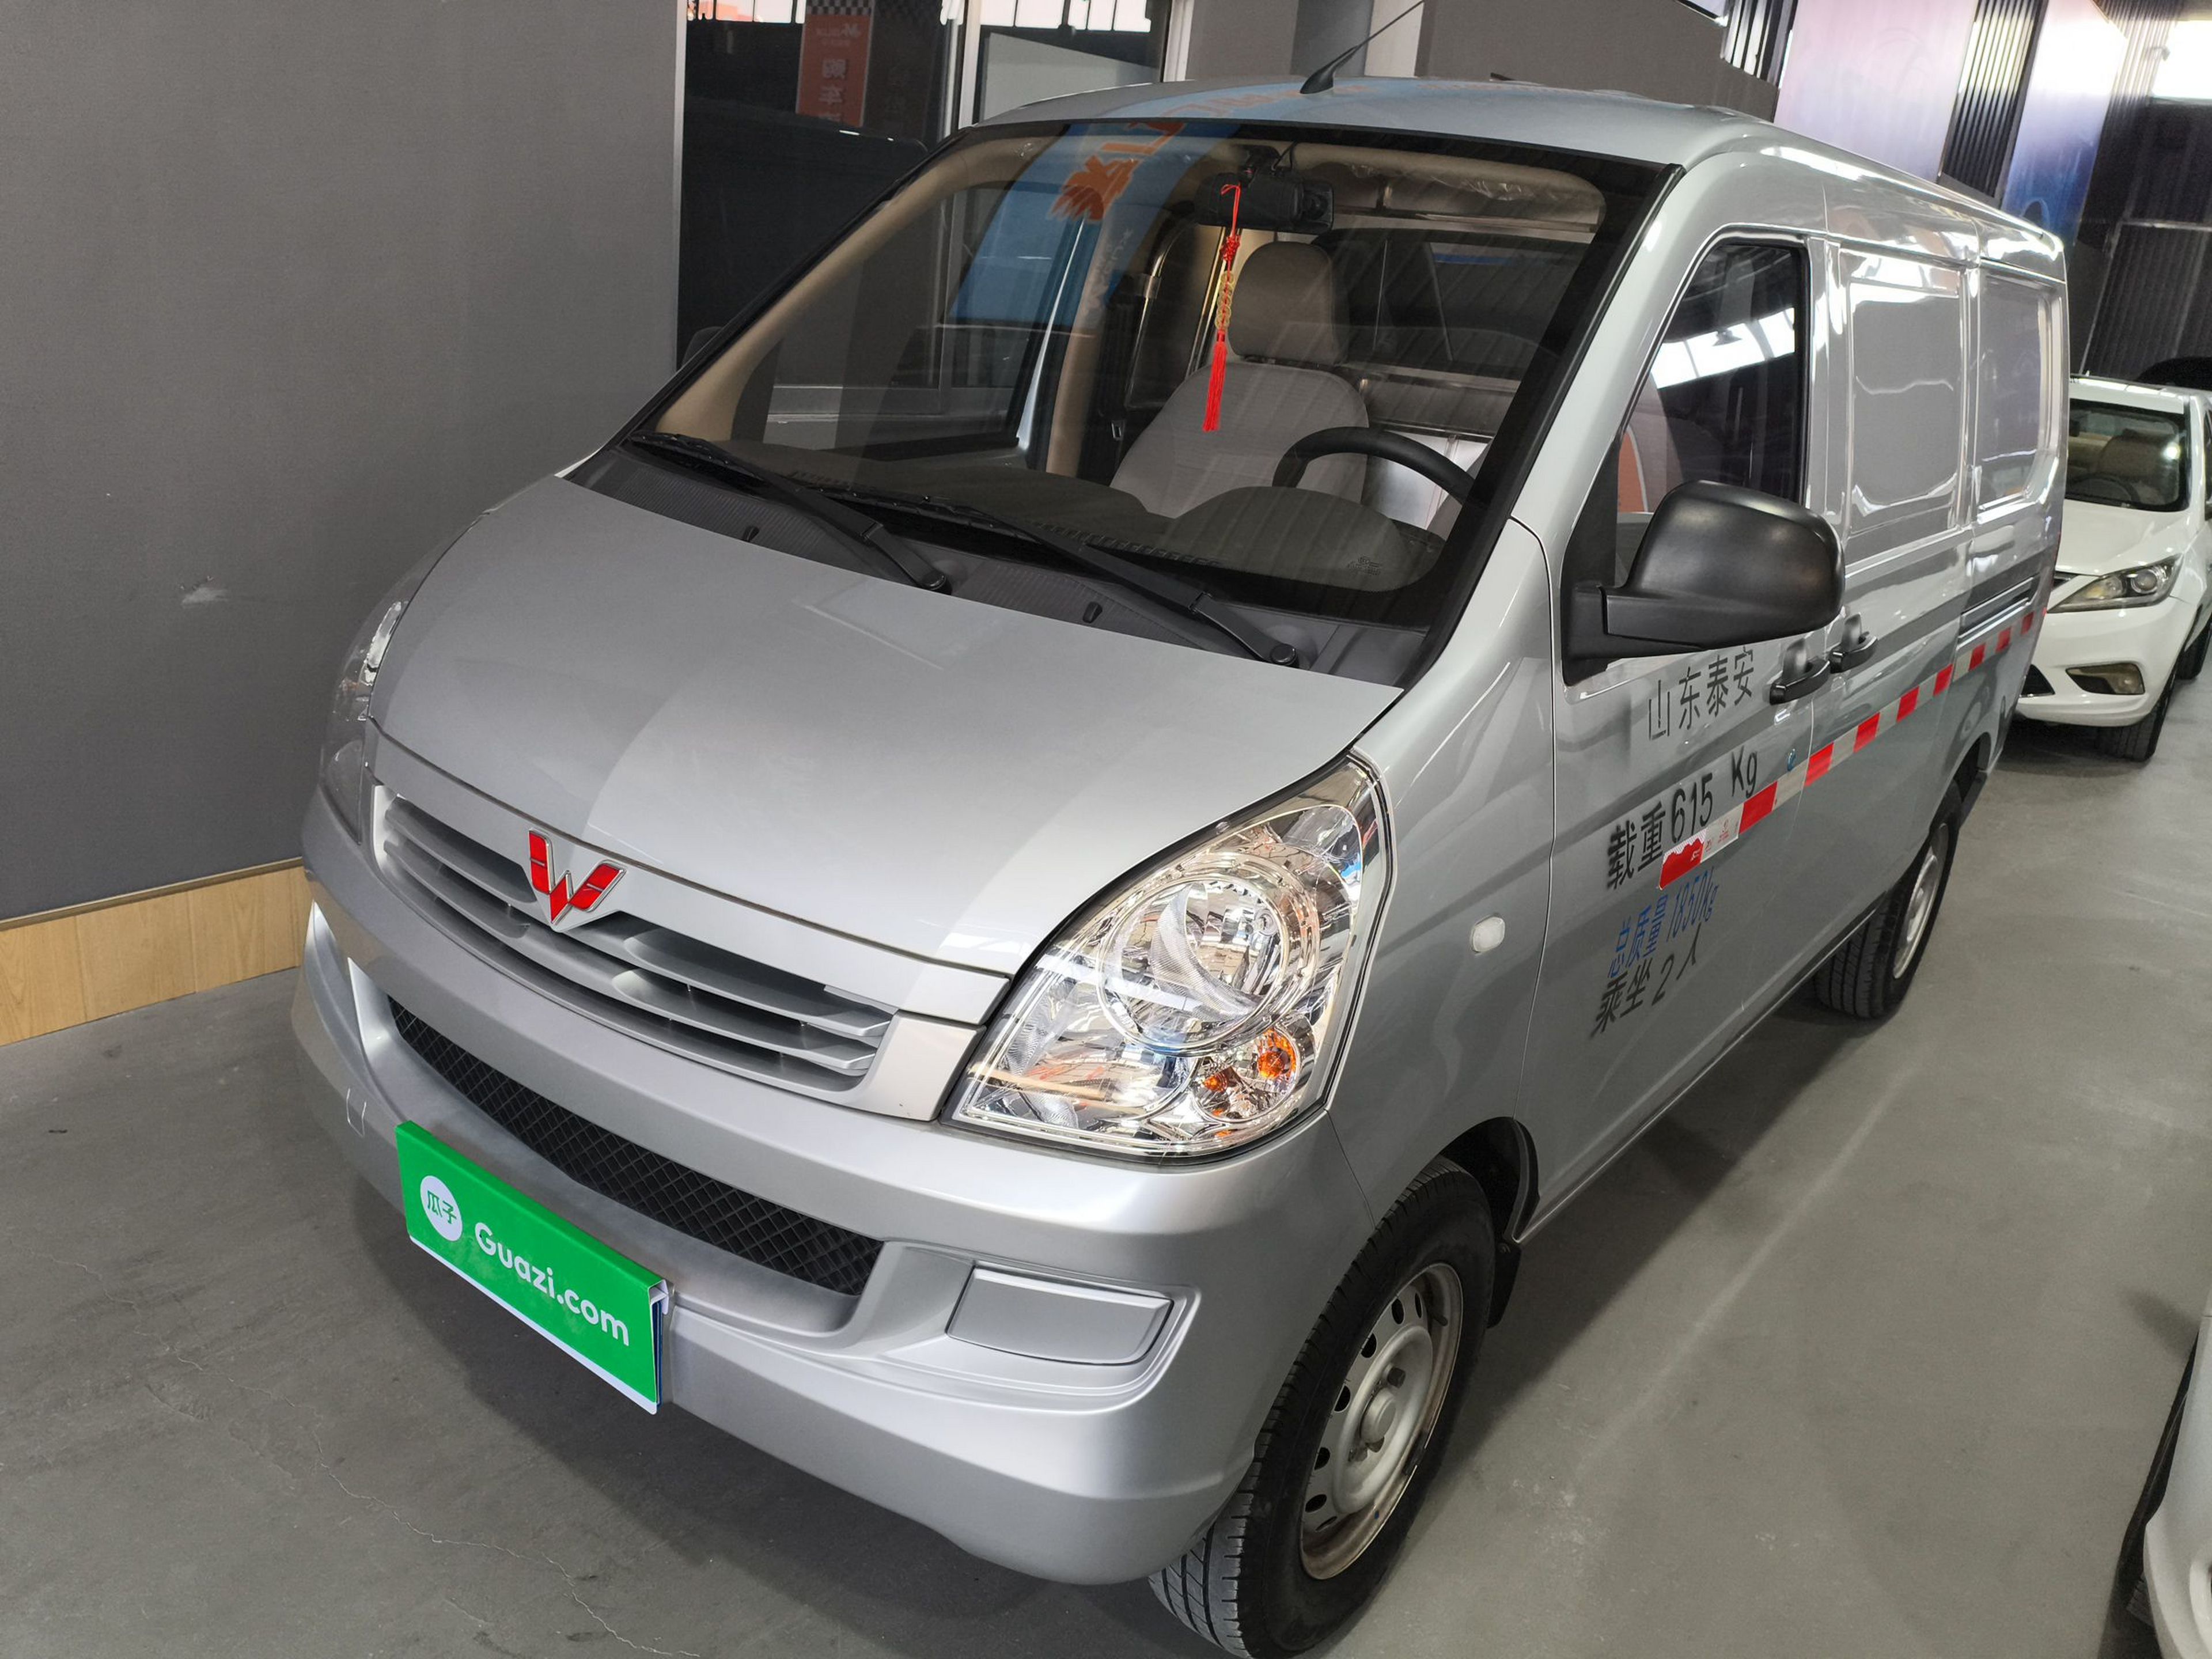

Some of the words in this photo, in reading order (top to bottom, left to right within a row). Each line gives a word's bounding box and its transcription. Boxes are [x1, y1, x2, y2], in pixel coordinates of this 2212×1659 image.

[1648, 646, 1754, 741] 山东泰安
[1731, 745, 1758, 798] Kg
[427, 1190, 457, 1225] 瓜子
[475, 1222, 630, 1346] Guazi.com
